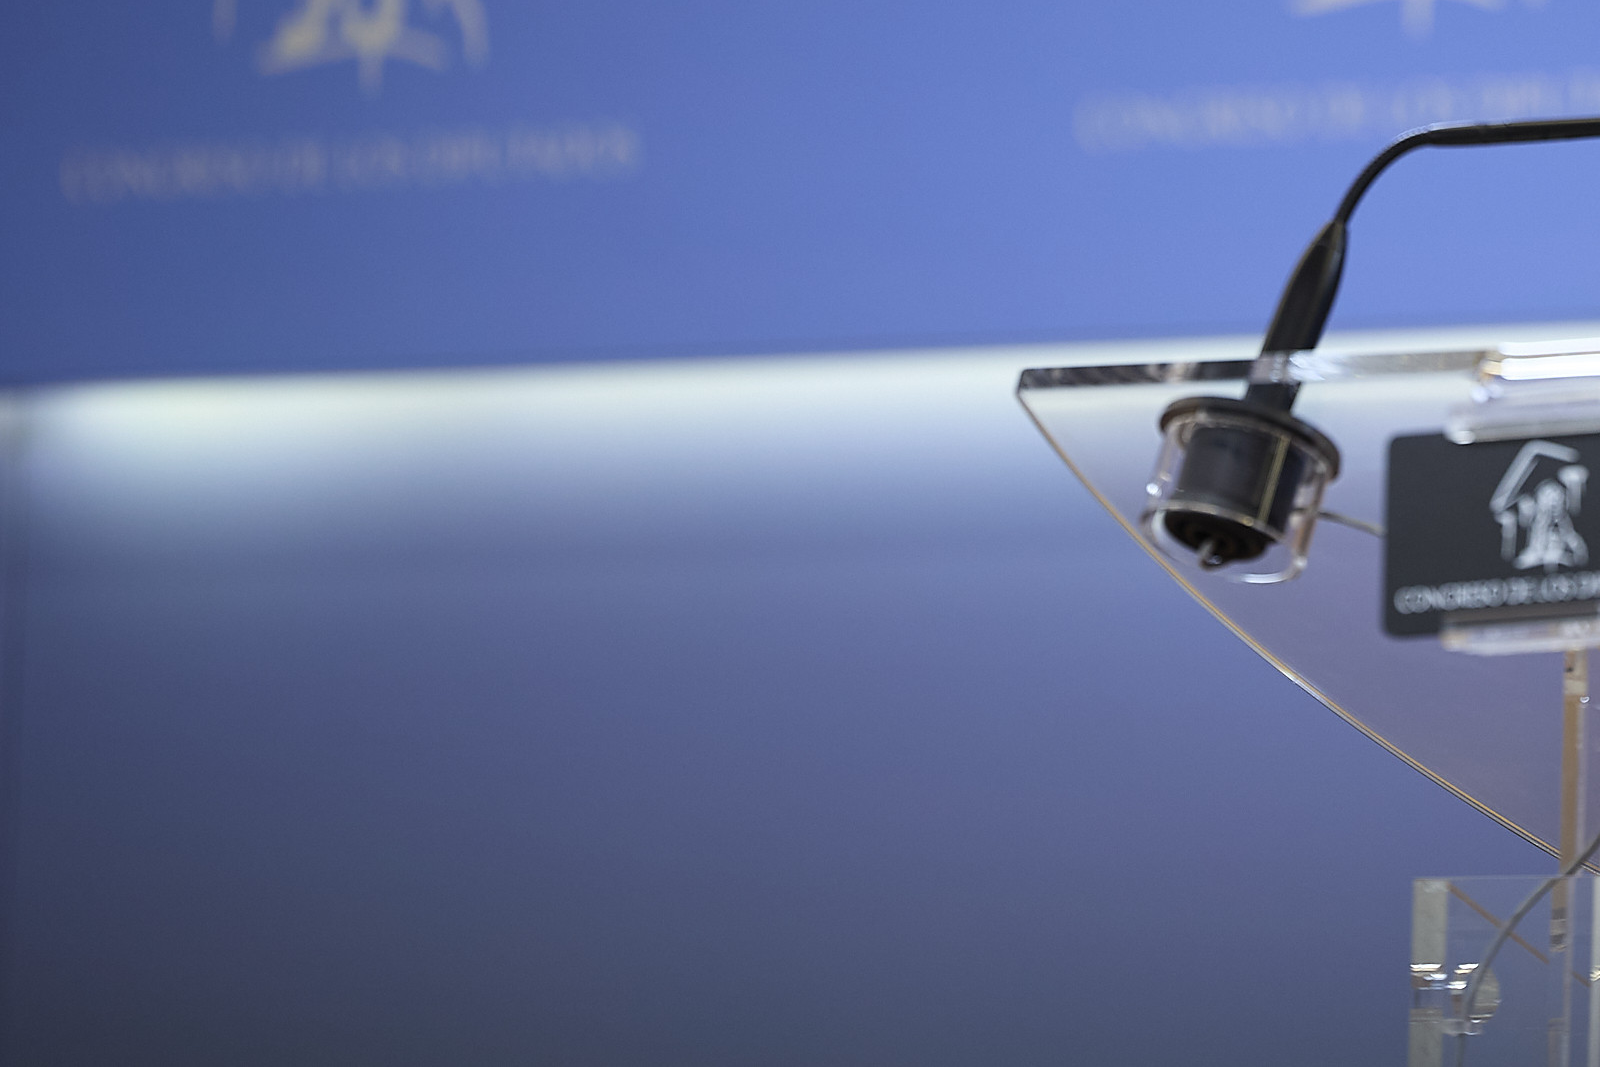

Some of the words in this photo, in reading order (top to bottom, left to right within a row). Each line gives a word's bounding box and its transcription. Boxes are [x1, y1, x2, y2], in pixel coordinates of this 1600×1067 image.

[1394, 581, 1506, 614] CONGRESO
[1504, 576, 1537, 606] DE
[1538, 572, 1576, 602] LOS
